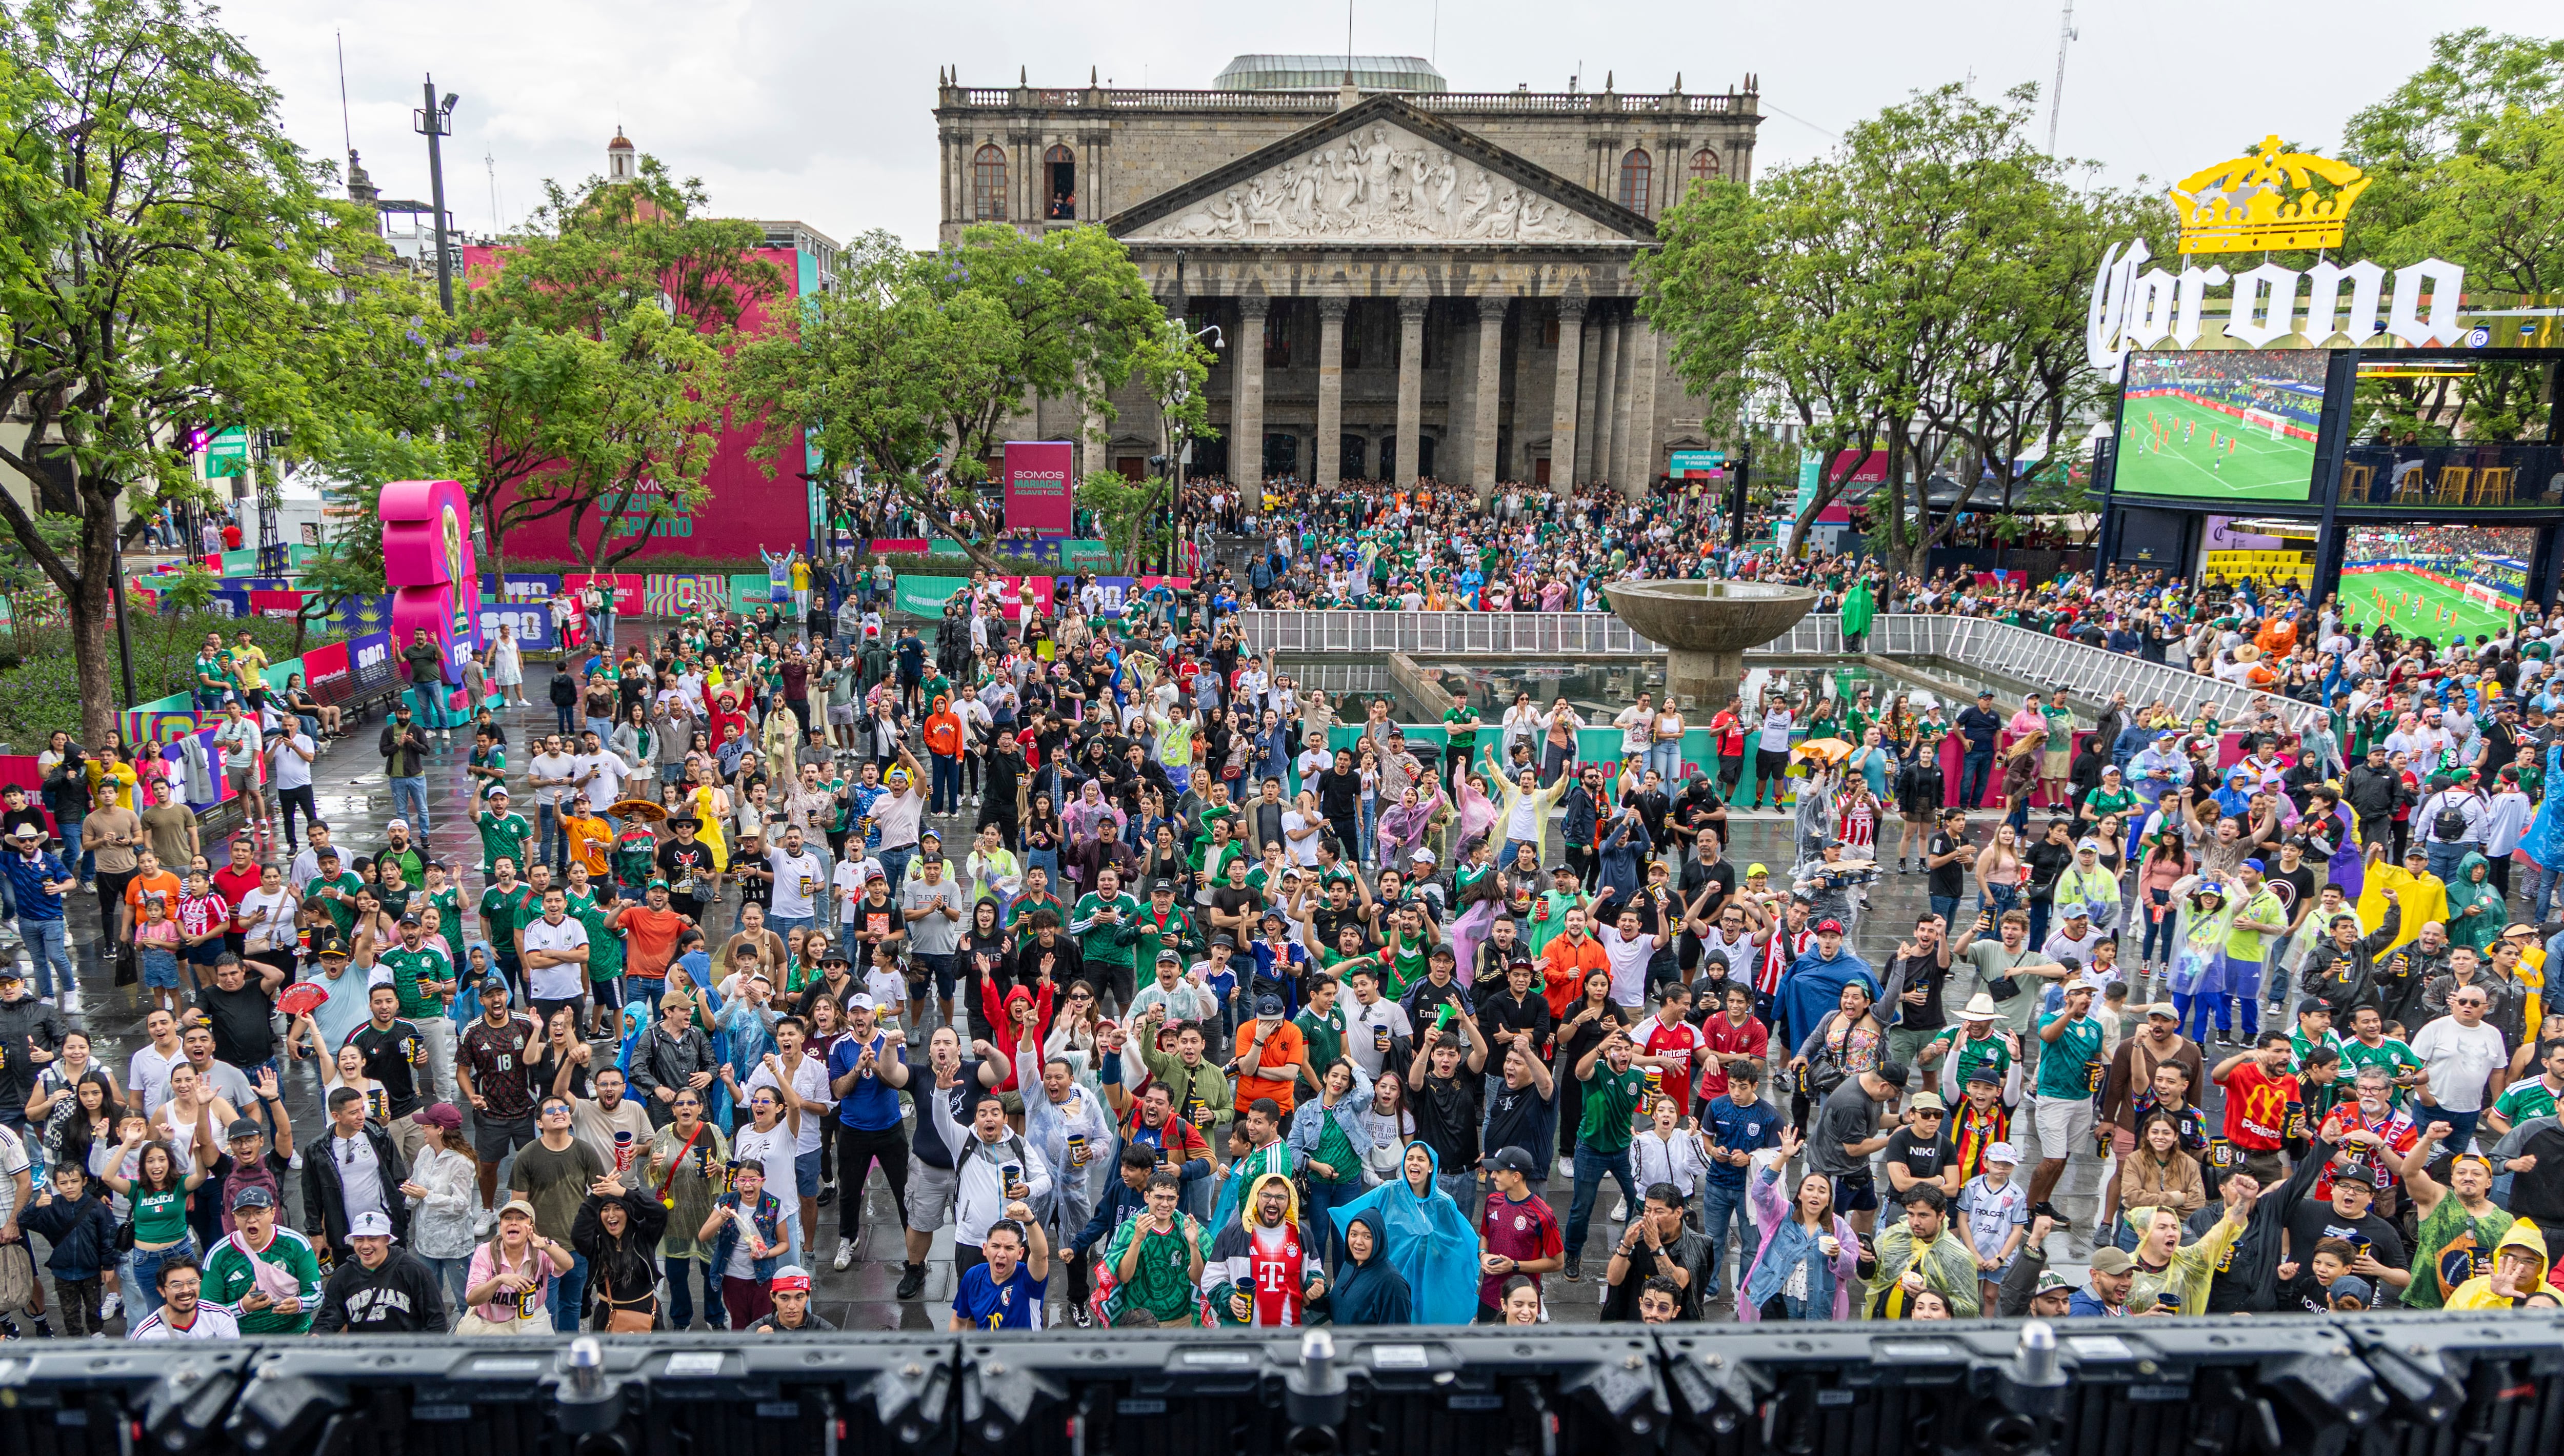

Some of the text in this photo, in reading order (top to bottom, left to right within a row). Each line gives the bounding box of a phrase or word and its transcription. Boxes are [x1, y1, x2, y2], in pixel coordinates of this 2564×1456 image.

[1515, 267, 1591, 276] DISCORDIA
[2087, 237, 2469, 384] Corona
[1014, 471, 1064, 479] SOMOS
[1014, 479, 1064, 490] MARIACHI,
[454, 641, 473, 666] FIFA
[932, 722, 955, 734] HOLLAND
[724, 743, 743, 760] GAP
[971, 953, 1001, 964] LI'S
[807, 1047, 819, 1057] 26
[1655, 1048, 1691, 1057] Emirates
[497, 1054, 512, 1071] 18
[2241, 1118, 2280, 1139] Palace
[141, 1194, 174, 1206] MÉXICO
[1975, 1208, 2005, 1220] ROLCAR
[1260, 1262, 1285, 1291] T
